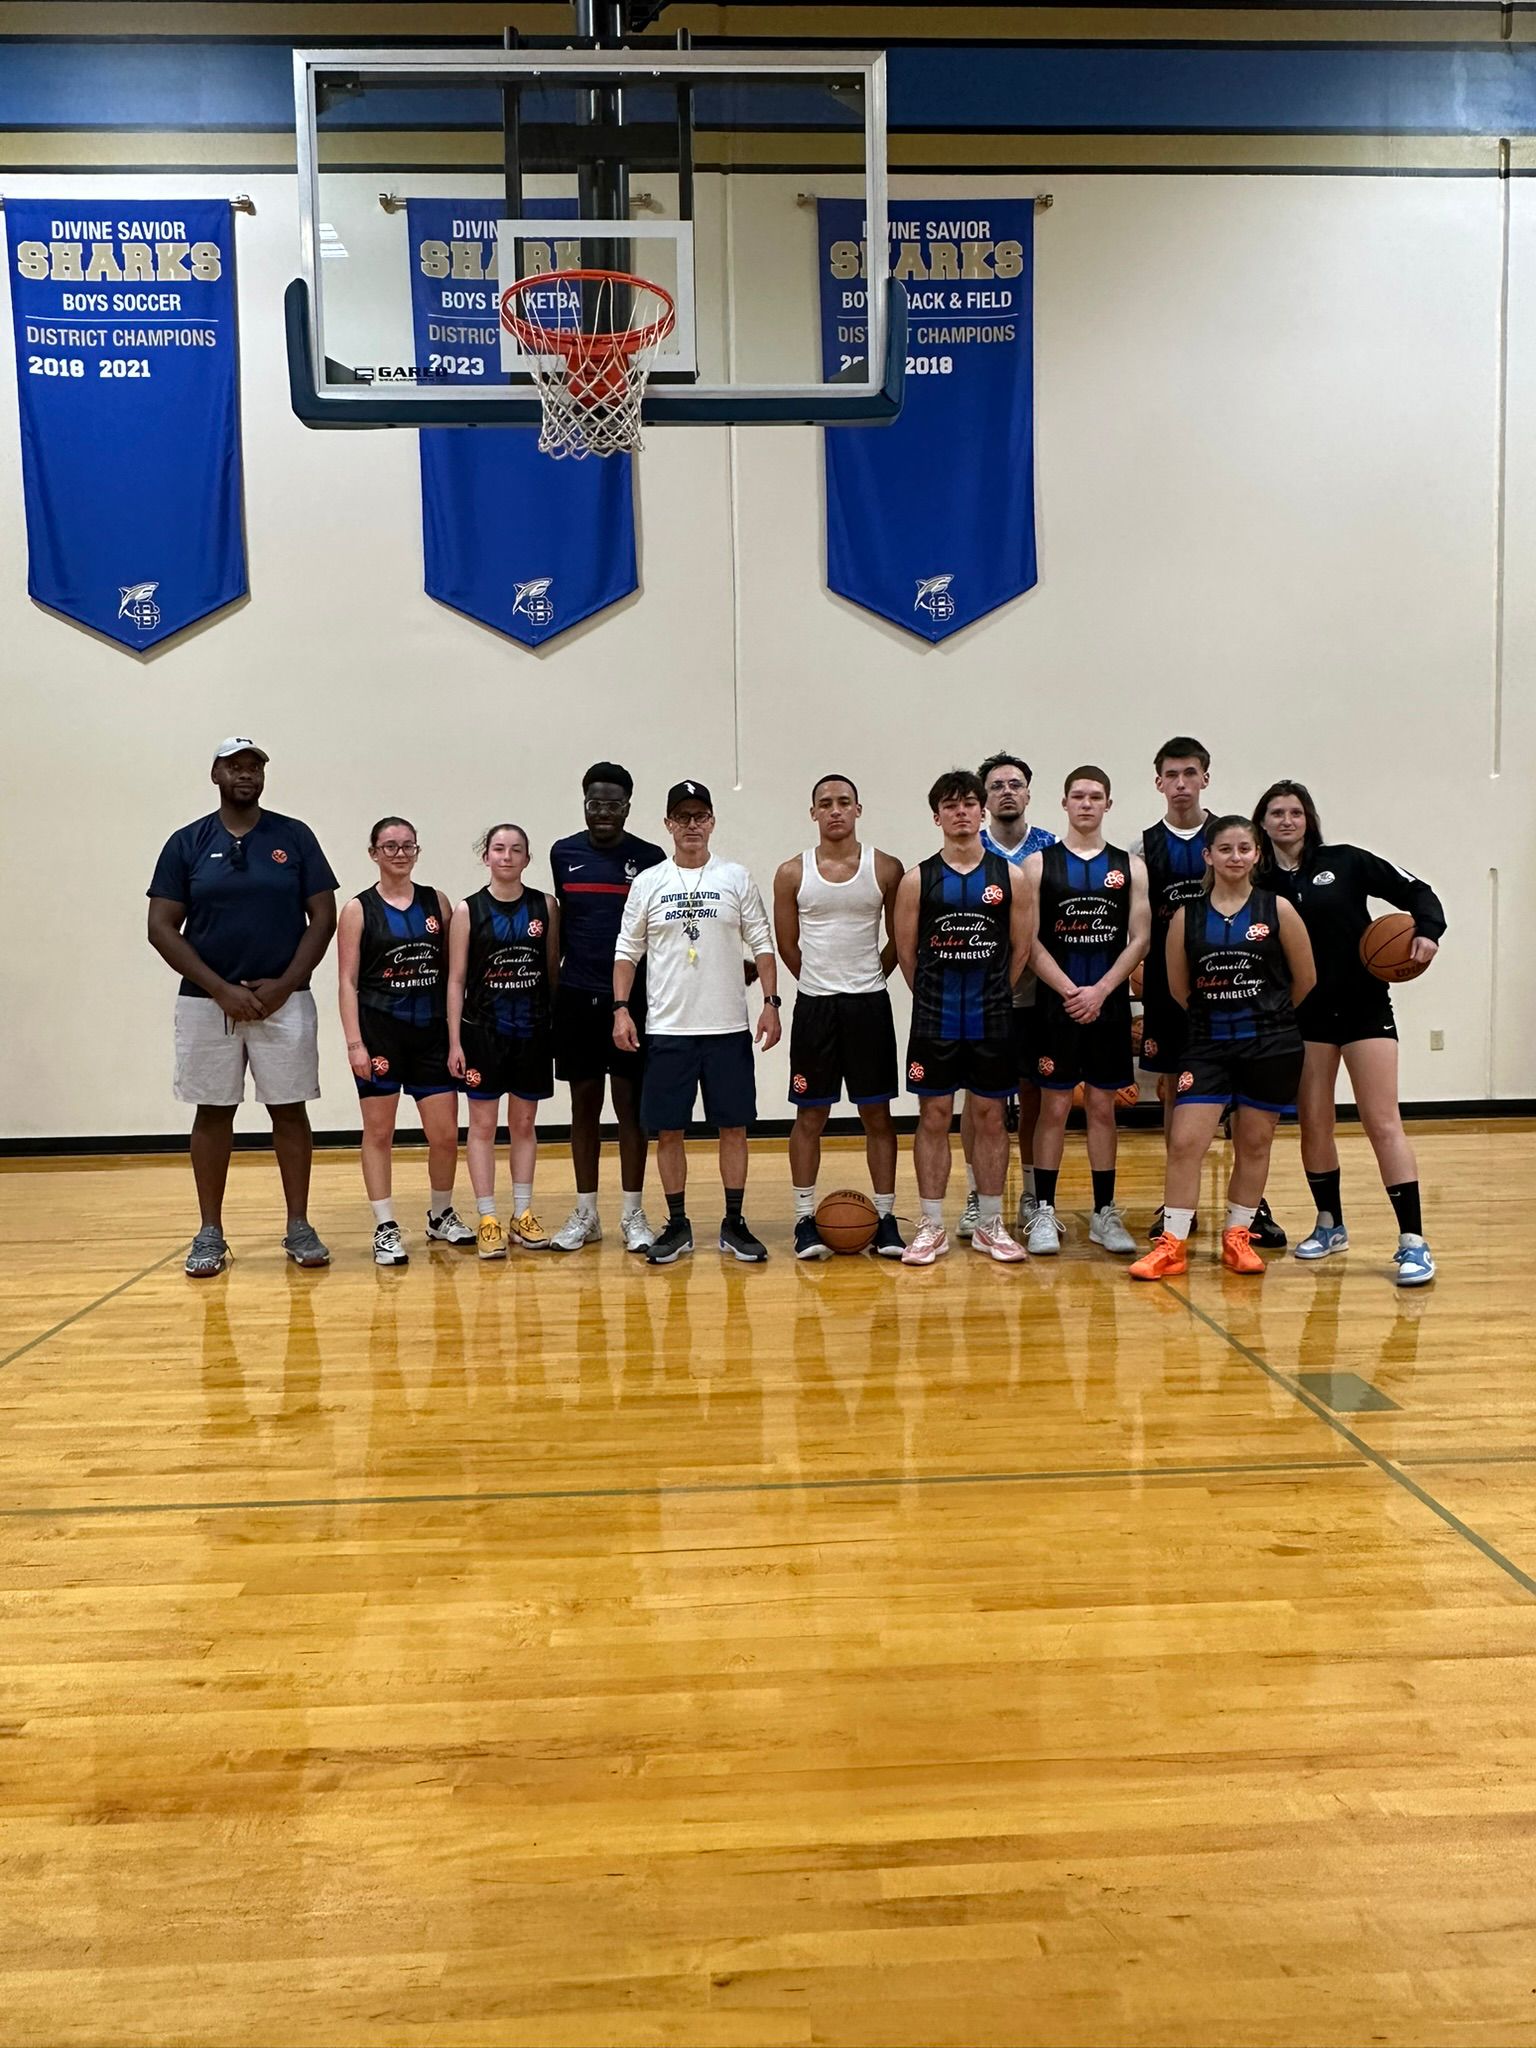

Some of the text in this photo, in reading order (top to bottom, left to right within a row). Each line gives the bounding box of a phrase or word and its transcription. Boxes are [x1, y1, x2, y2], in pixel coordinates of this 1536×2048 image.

[51, 221, 186, 240] DIVINE SAVIOR
[453, 219, 499, 239] DIVIN
[926, 220, 990, 240] SAVIOR
[17, 241, 222, 281] SHARKS
[420, 240, 582, 280] SHRK
[830, 240, 1024, 280] SARKS
[63, 293, 181, 311] BOYS SOCCER
[442, 291, 580, 309] BOYS BKETBA
[949, 292, 962, 309] &
[967, 291, 1012, 309] FIELD
[27, 326, 216, 347] DISTRICT CHAMPIONS
[917, 324, 1015, 344] CHAMPIONS
[28, 356, 151, 378] 2018 2021
[378, 367, 448, 378] GARED
[429, 354, 485, 375] 2023
[904, 356, 953, 375] 2018
